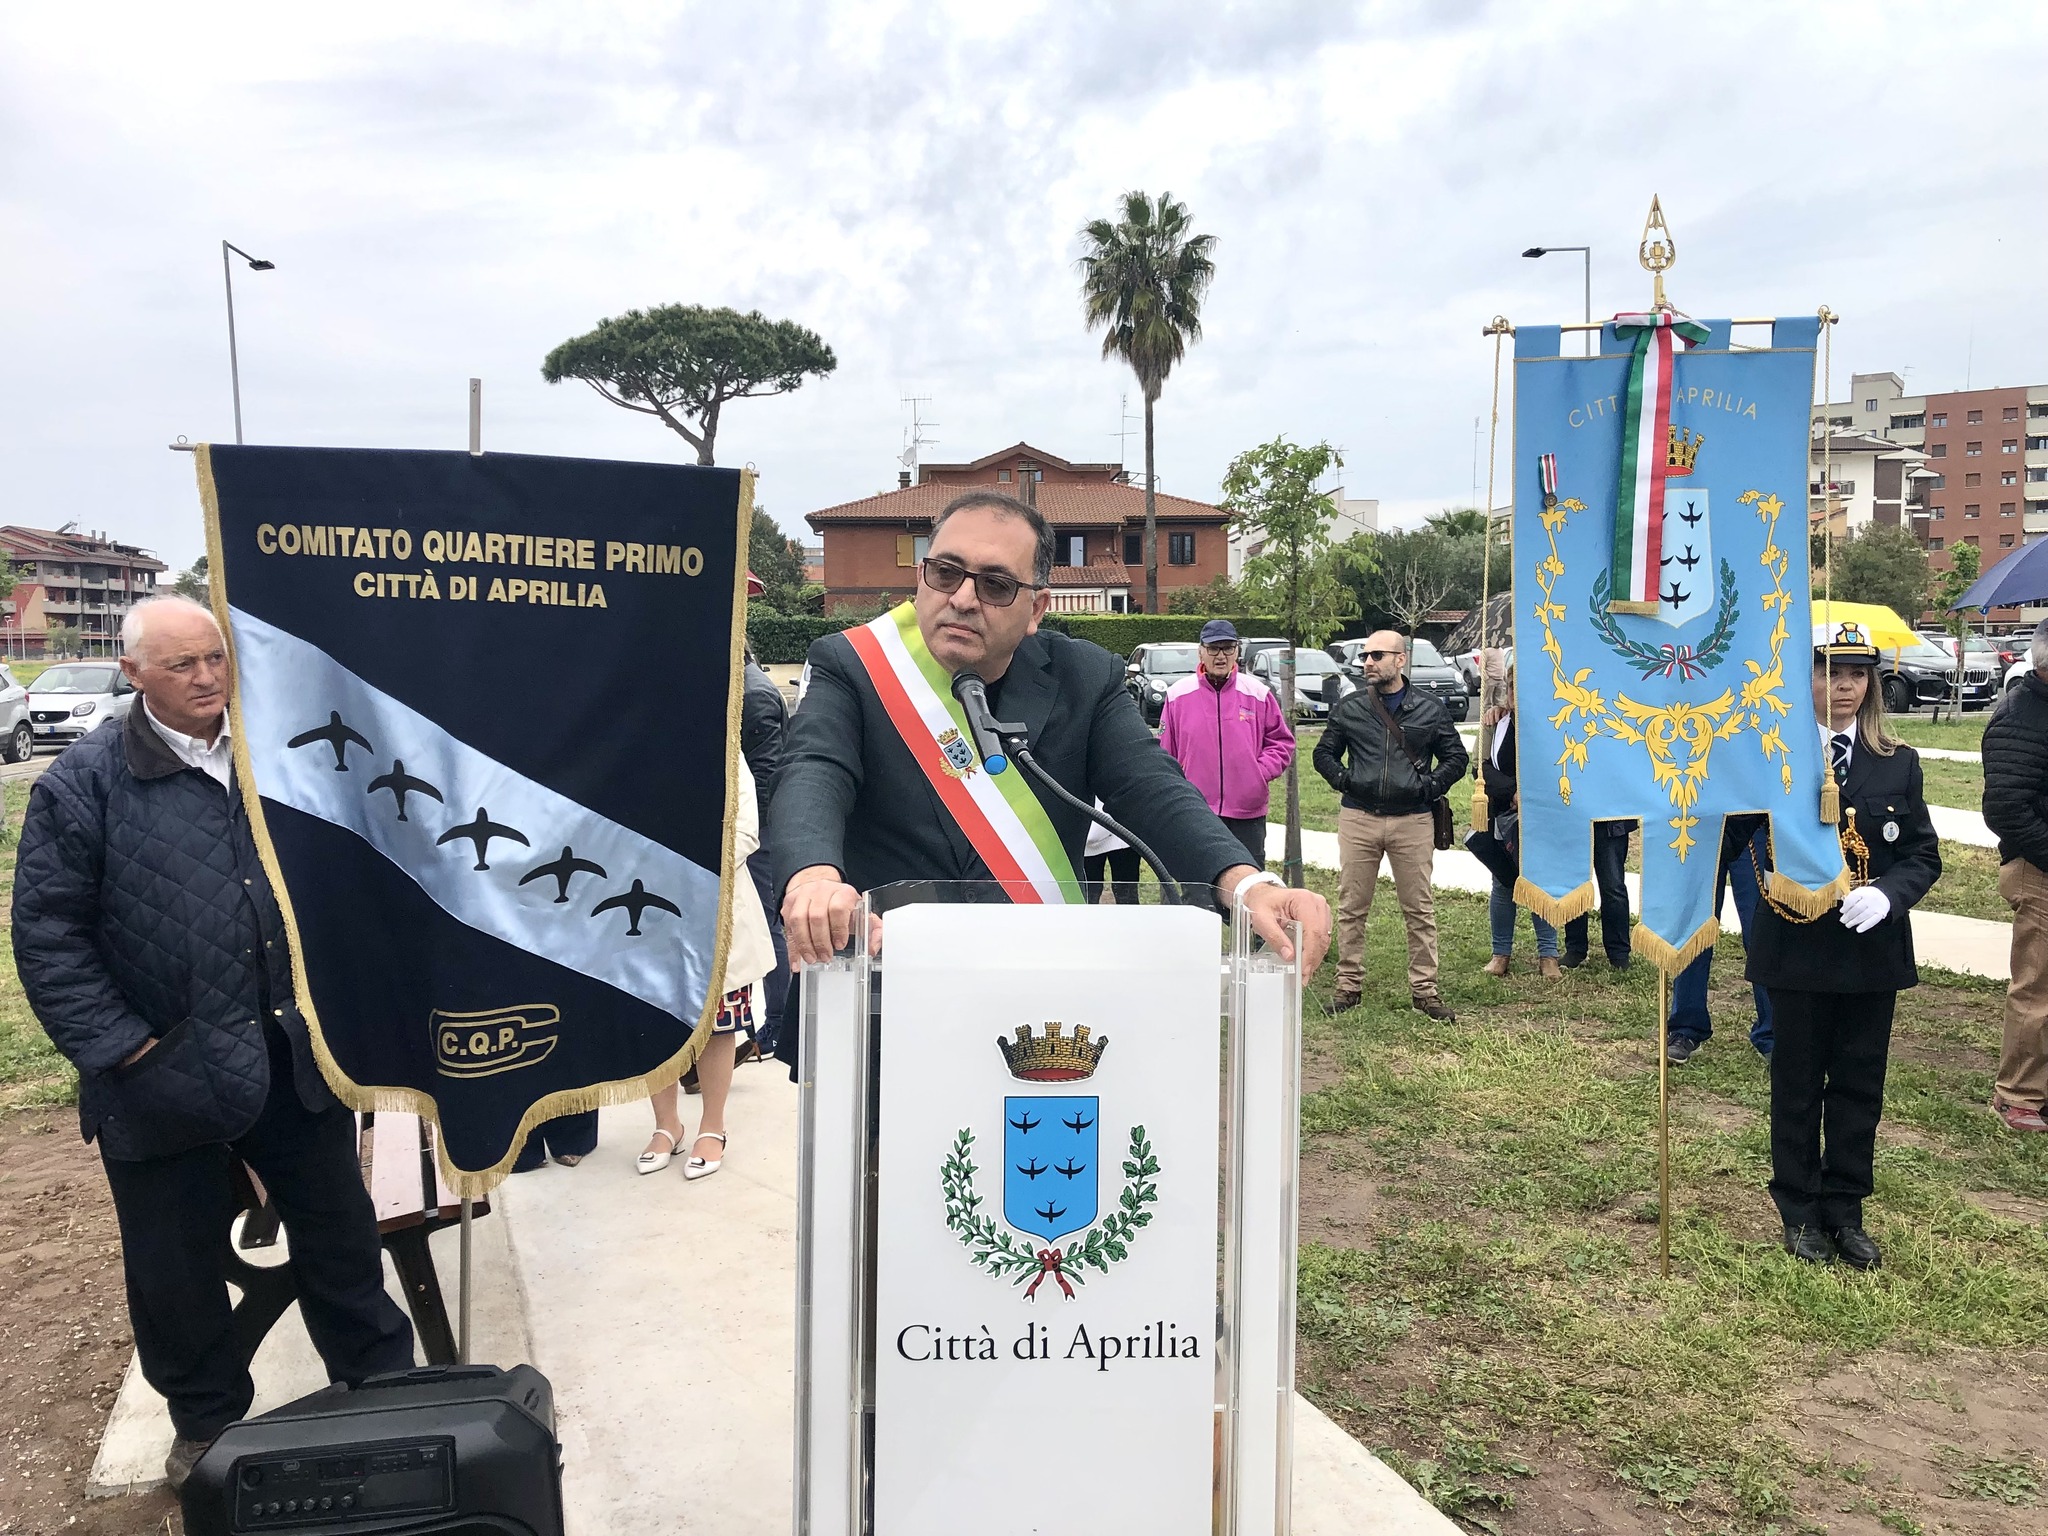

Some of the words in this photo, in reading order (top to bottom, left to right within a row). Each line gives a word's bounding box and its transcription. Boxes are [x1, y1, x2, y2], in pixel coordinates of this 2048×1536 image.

[1568, 395, 1618, 428] CITT
[1676, 386, 1758, 420] APRILIA
[256, 523, 412, 560] COMITATO
[422, 529, 596, 570] QUARTIERE
[605, 541, 705, 577] PRIMO
[353, 568, 440, 600] CITTÀ
[449, 575, 477, 601] DI
[487, 577, 608, 608] APRILIA
[441, 1027, 518, 1056] C.Q.P.
[896, 1323, 999, 1362] Città
[1012, 1321, 1051, 1361] di
[1063, 1320, 1201, 1372] Aprilia
